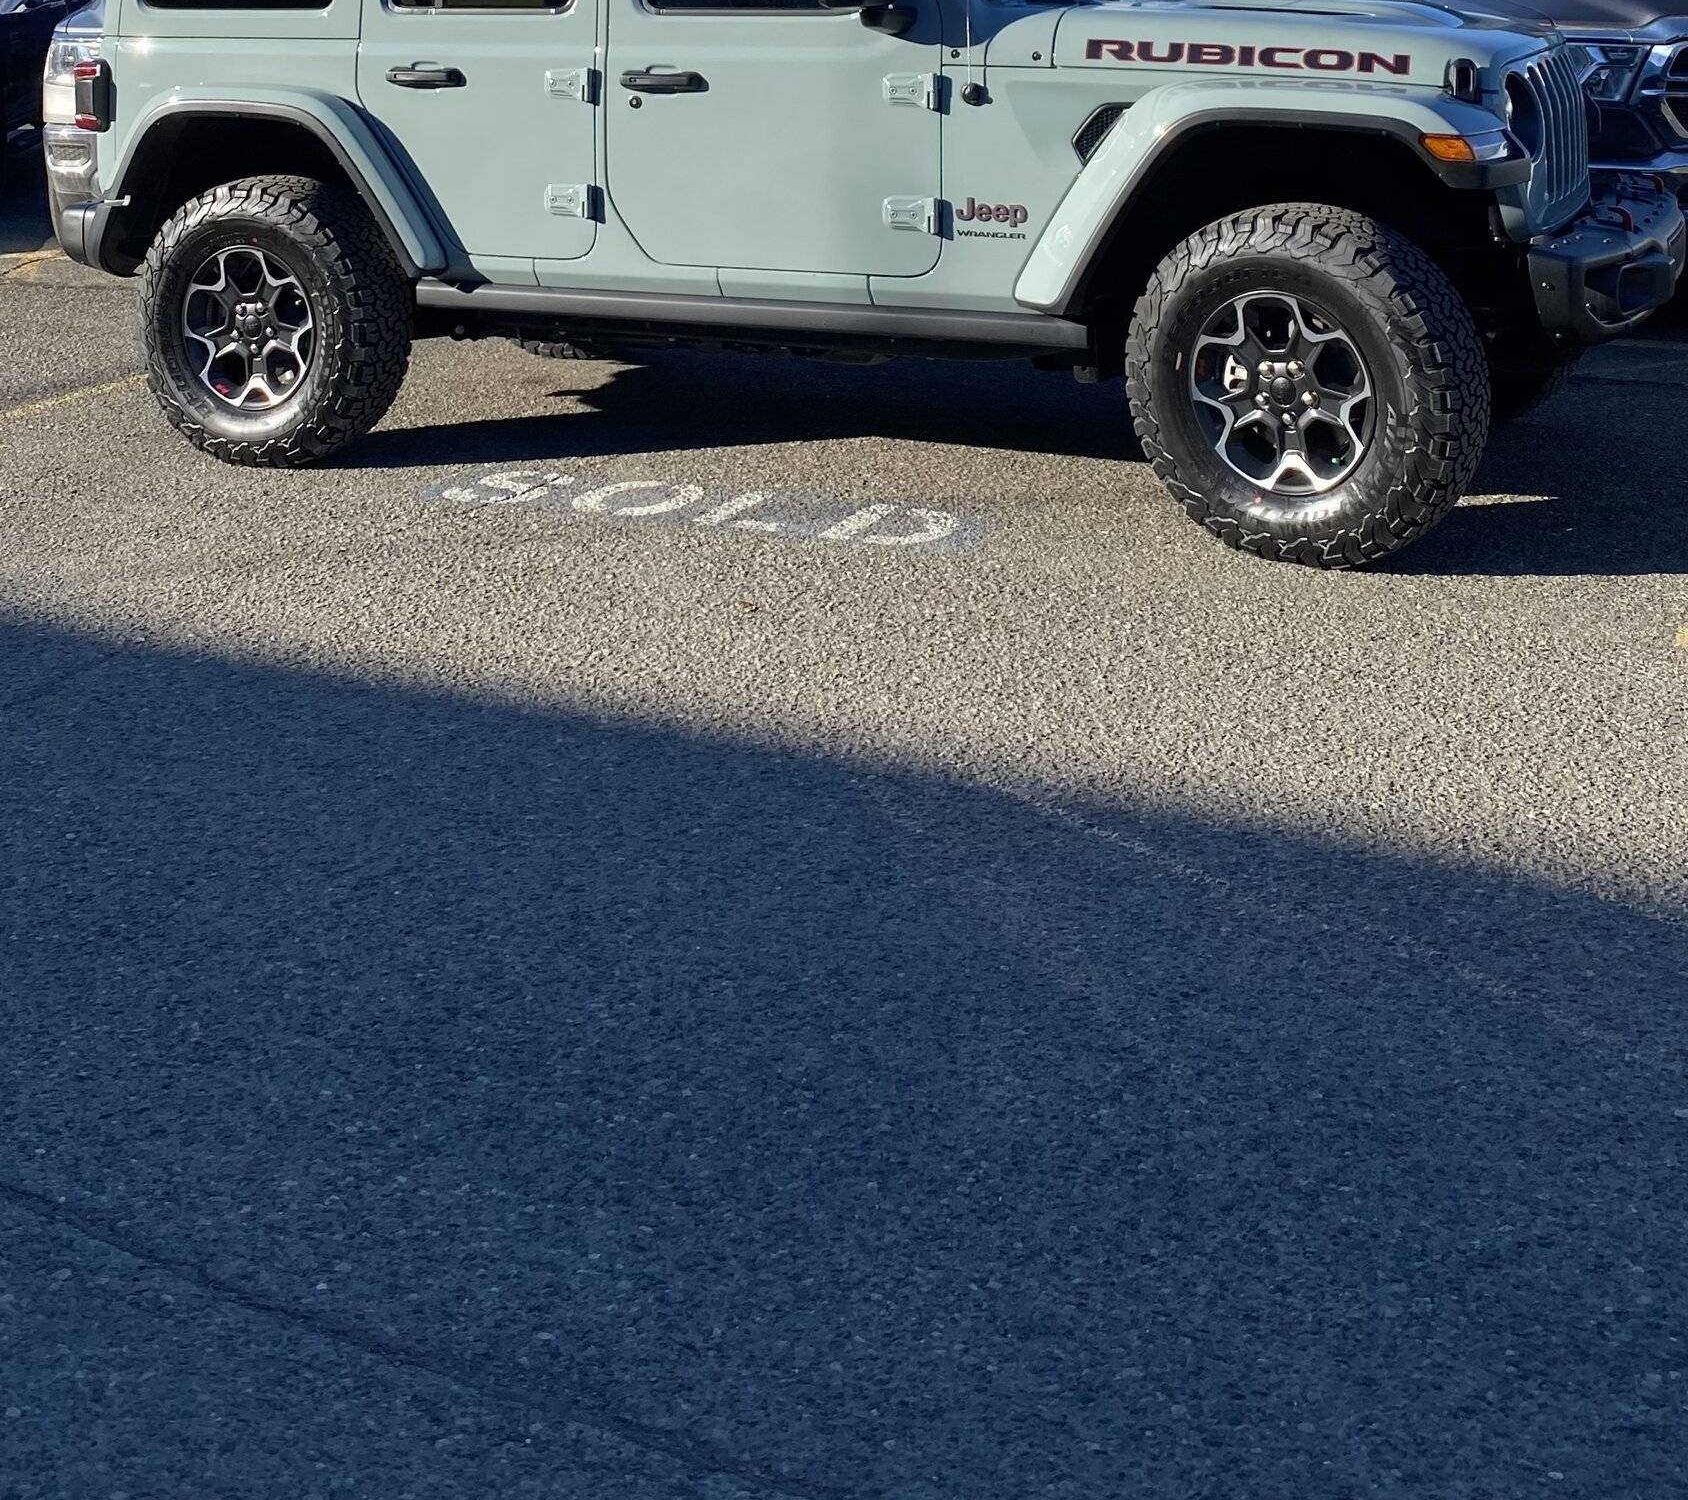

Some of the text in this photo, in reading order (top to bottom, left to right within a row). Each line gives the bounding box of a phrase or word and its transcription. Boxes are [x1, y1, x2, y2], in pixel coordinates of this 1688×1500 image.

[1085, 38, 1411, 75] RUBICON
[955, 197, 1028, 228] Jeep
[956, 229, 1026, 240] WRANGLER
[442, 470, 960, 545] SOLD
